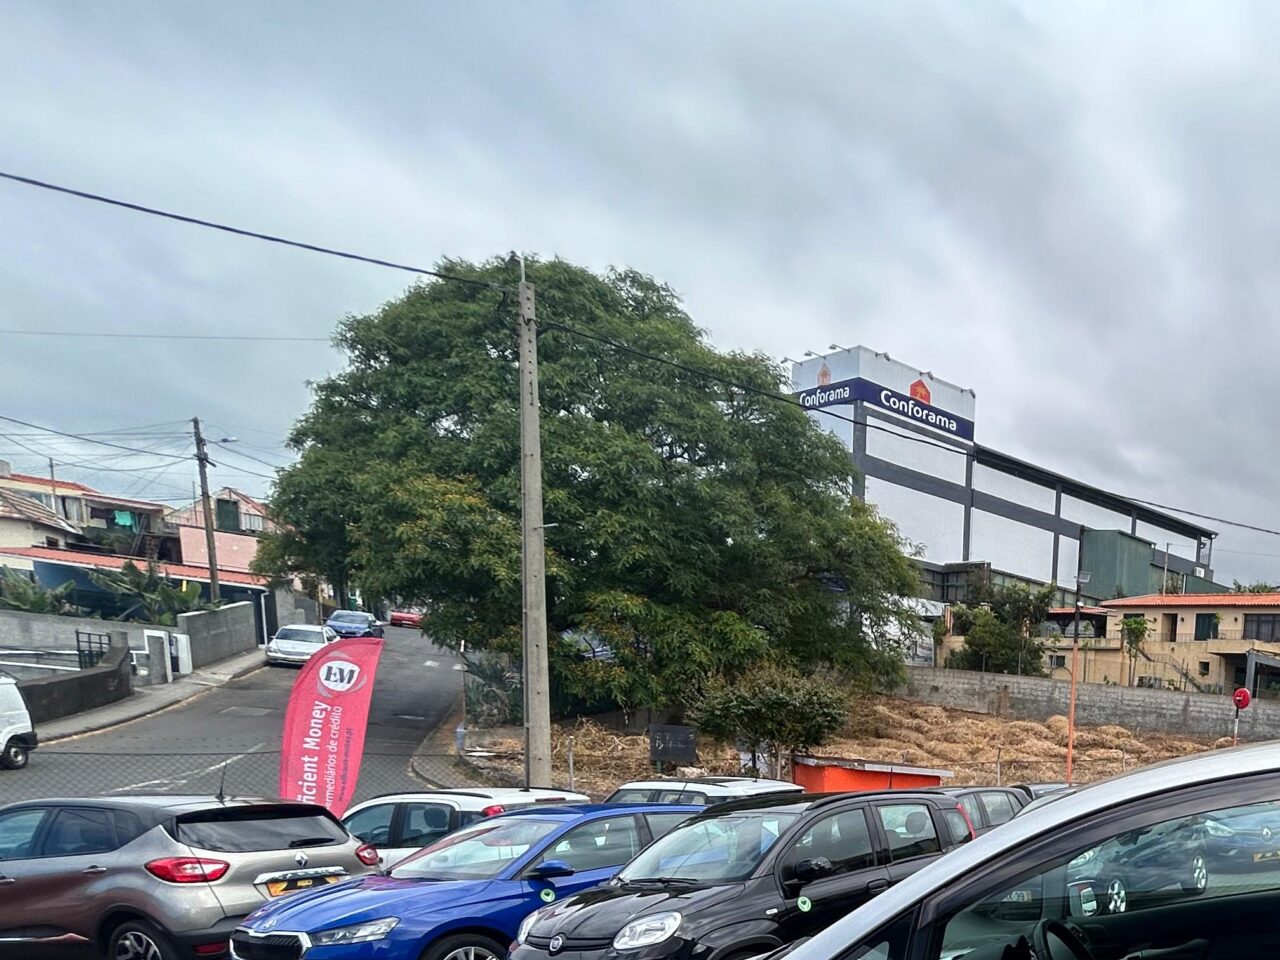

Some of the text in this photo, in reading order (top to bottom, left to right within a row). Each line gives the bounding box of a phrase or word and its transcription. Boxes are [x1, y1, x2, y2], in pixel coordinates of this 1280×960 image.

[800, 386, 850, 407] Conforama
[880, 389, 957, 432] Conforama
[324, 665, 356, 685] EM
[302, 701, 331, 750] Money
[323, 706, 343, 809] ermediários de crédito
